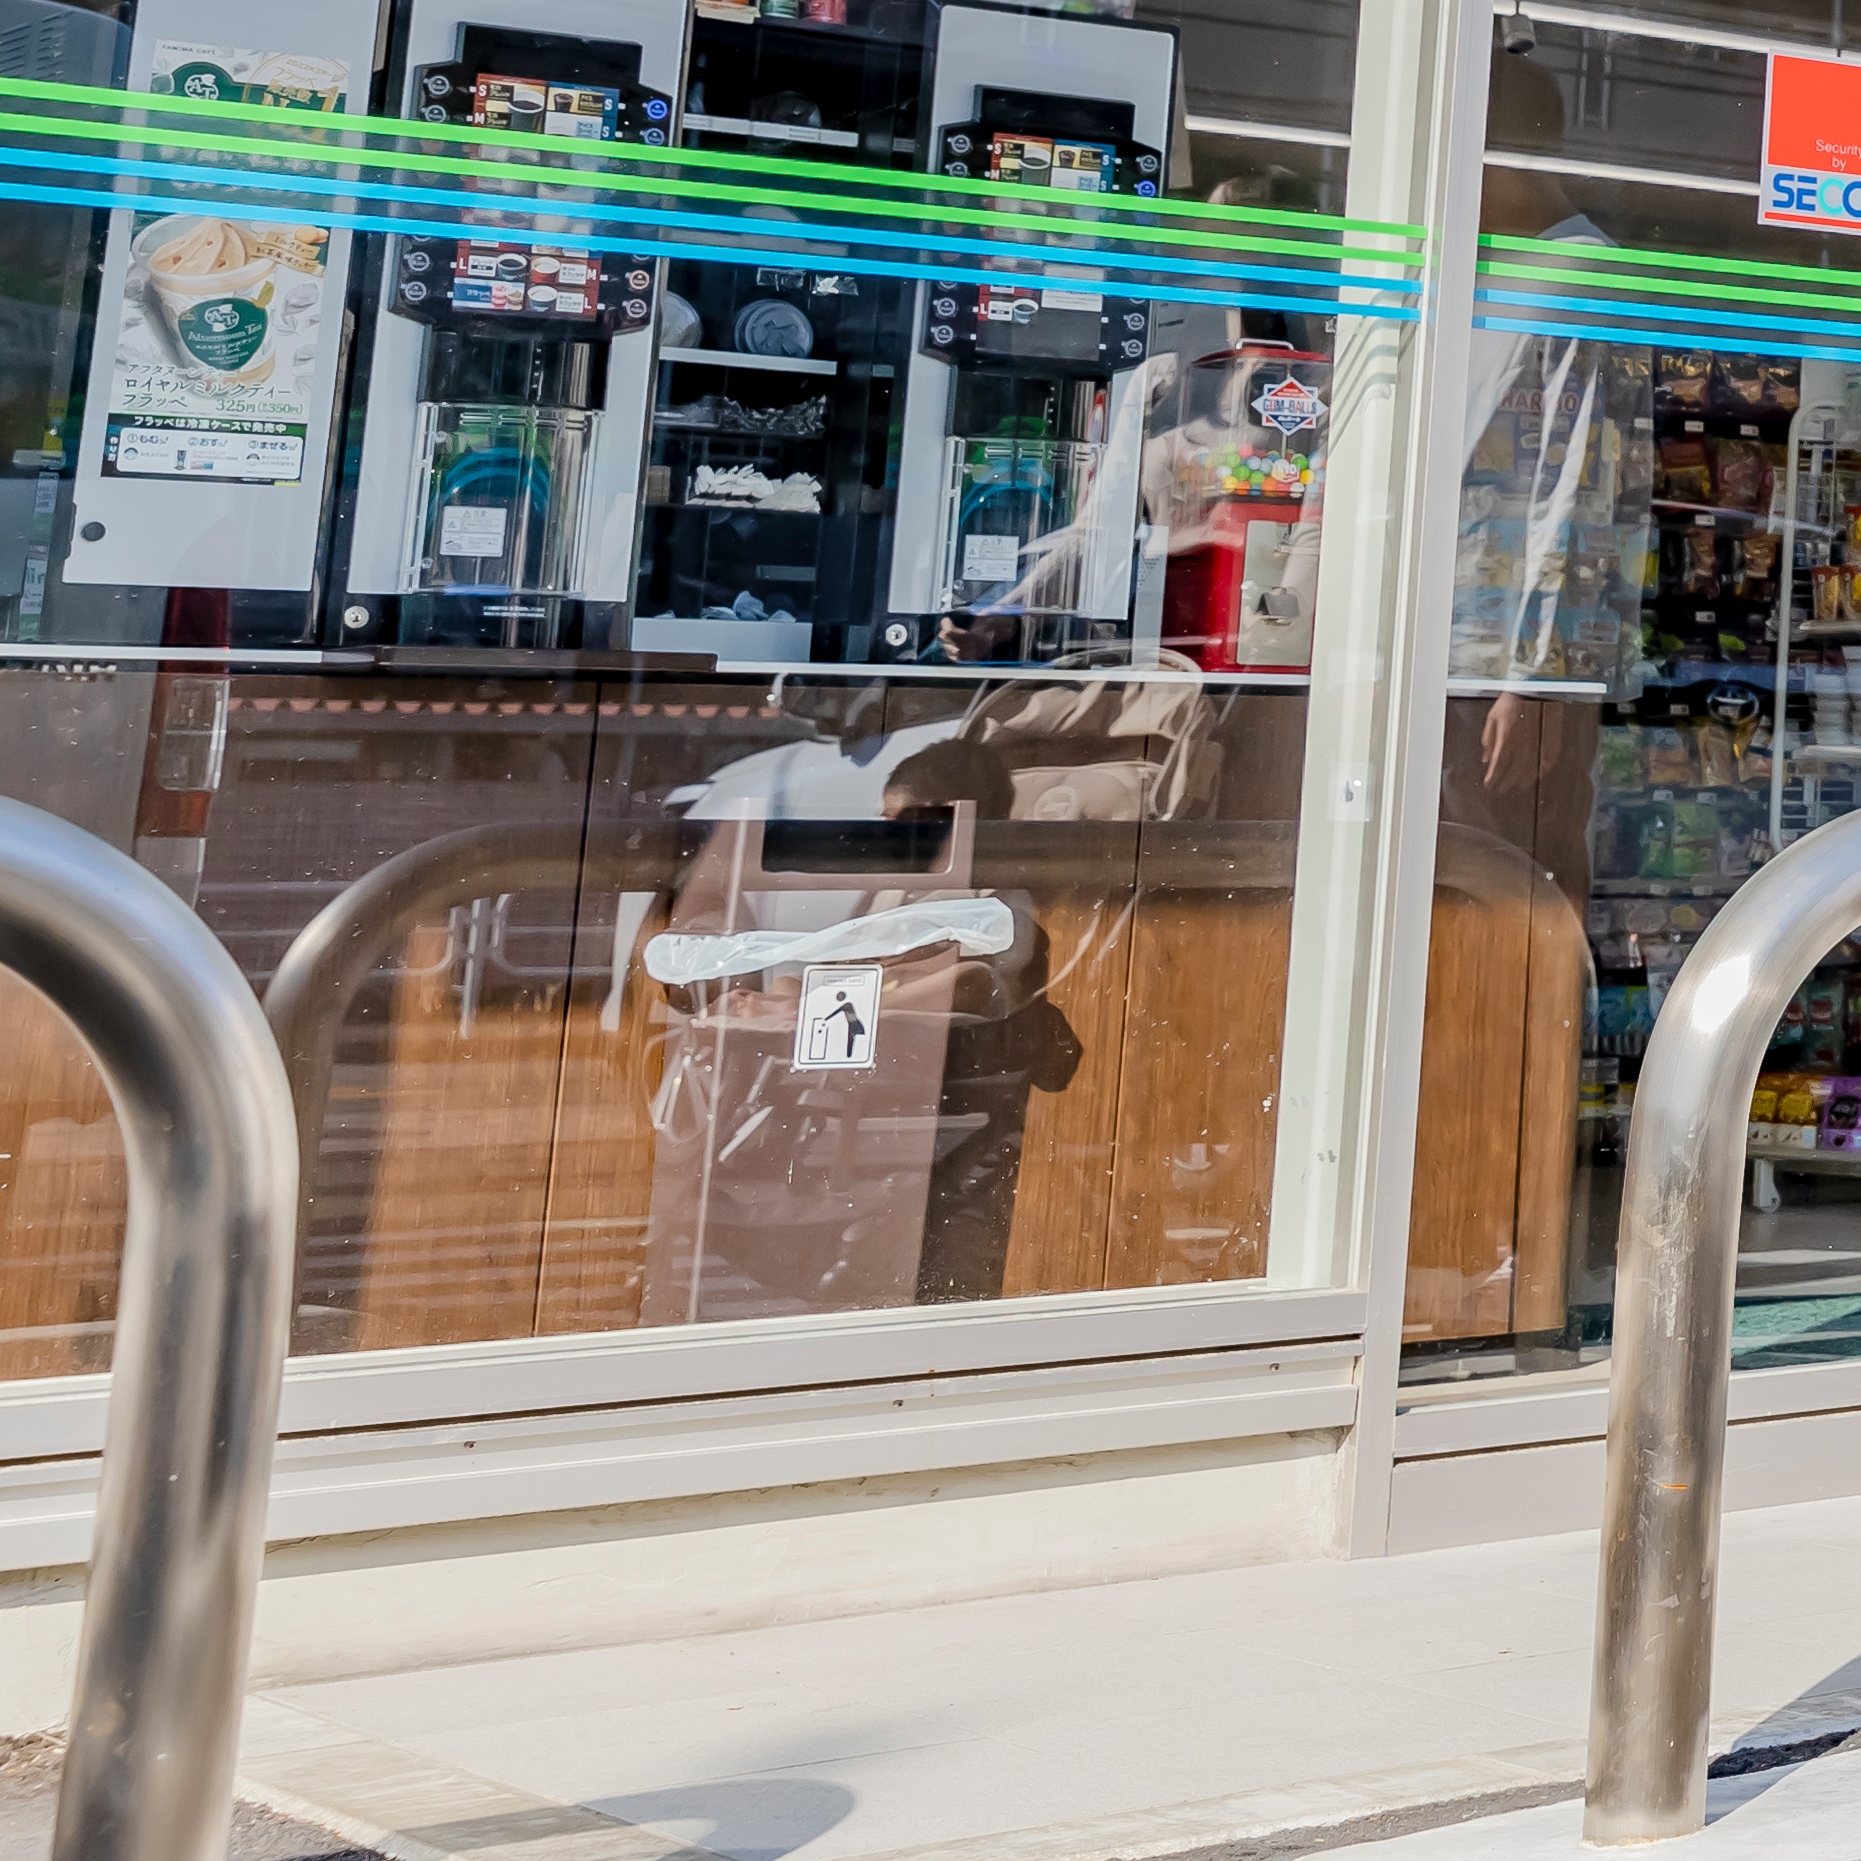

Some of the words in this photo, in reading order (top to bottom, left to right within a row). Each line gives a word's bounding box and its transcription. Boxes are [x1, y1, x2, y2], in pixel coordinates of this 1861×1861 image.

[478, 84, 487, 97] S
[604, 99, 613, 111] S
[474, 112, 485, 125] M
[602, 126, 610, 138] S
[994, 143, 1002, 154] S
[1102, 154, 1110, 166] S
[1832, 156, 1847, 171] by
[459, 257, 468, 270] L
[586, 268, 597, 281] M
[584, 297, 592, 309] L
[980, 303, 988, 316] L
[125, 377, 291, 399] ロイヤルミルクティー
[122, 393, 188, 408] フラッペ
